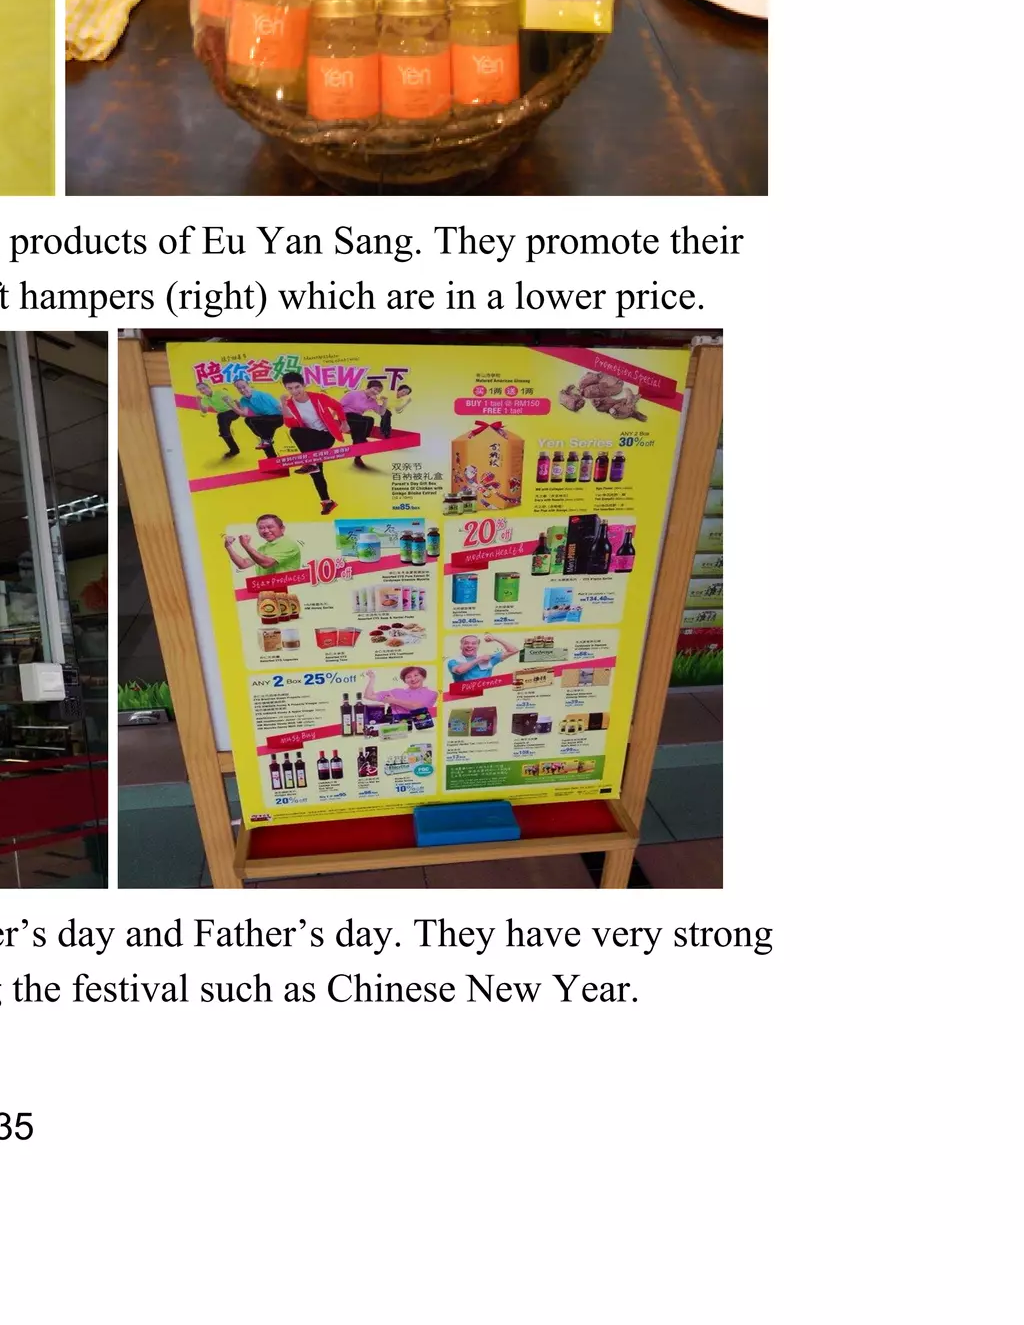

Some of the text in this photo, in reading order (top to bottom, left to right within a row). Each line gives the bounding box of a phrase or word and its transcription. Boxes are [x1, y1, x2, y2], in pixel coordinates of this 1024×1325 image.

[10, 226, 146, 262] products
[159, 226, 195, 254] of
[202, 227, 246, 254] Eu
[257, 227, 322, 254] Yan
[335, 226, 420, 262] Sang.
[434, 226, 515, 262] They
[526, 230, 659, 262] promote
[670, 226, 744, 254] their
[20, 281, 154, 317] hampers
[167, 281, 266, 317] (right)
[278, 281, 375, 309] which
[387, 290, 434, 309] are
[447, 281, 476, 309] in
[488, 290, 504, 309] a
[516, 281, 606, 309] lower
[616, 281, 703, 317] price.
[303, 365, 365, 390] NEW
[537, 437, 613, 448] Yen Series
[618, 437, 655, 447] 30% off
[273, 675, 284, 688] 2
[304, 672, 343, 686] 25%
[343, 674, 357, 684] off
[59, 918, 115, 955] day
[127, 918, 183, 947] and
[194, 918, 323, 947] Father’s
[336, 918, 400, 955] day.
[414, 918, 495, 955] They
[506, 918, 580, 947] have
[592, 928, 662, 955] very
[675, 923, 772, 955] strong
[13, 974, 60, 1002] the
[73, 974, 188, 1002] festival
[201, 974, 272, 1002] such
[285, 983, 315, 1002] as
[328, 974, 455, 1002] Chinese
[466, 975, 541, 1002] New
[552, 975, 637, 1002] Year.
